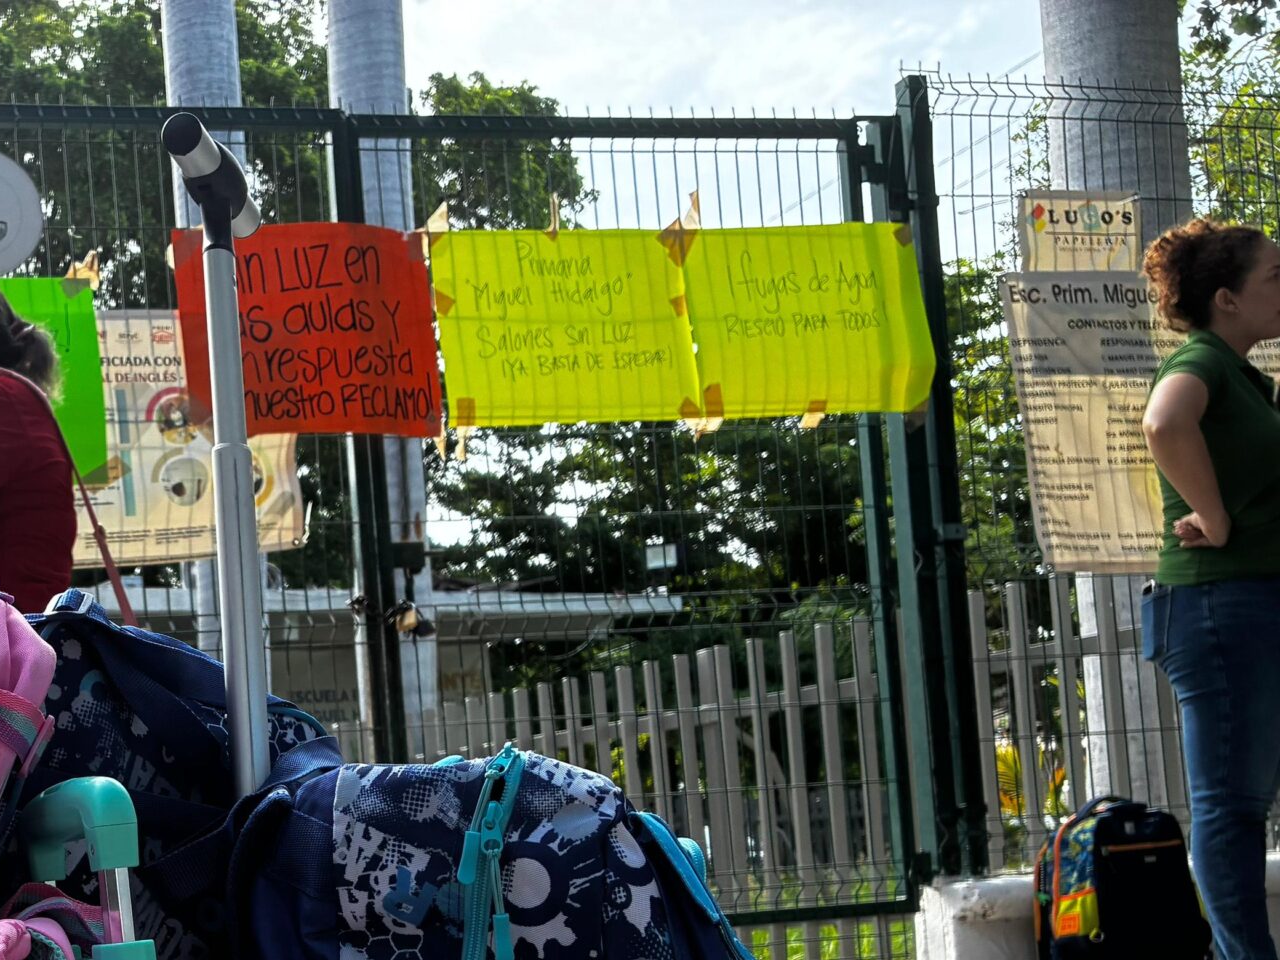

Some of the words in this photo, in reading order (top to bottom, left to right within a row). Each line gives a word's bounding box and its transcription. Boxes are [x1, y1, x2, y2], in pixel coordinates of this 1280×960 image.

[275, 244, 342, 293] LUZ
[344, 244, 380, 284] en
[513, 238, 593, 278] Primaria
[808, 258, 830, 293] de
[832, 260, 878, 305] Agua
[1008, 284, 1048, 304] Esc.
[1051, 283, 1099, 304] Prim.
[1103, 284, 1159, 309] Migue
[283, 293, 374, 335] aulas
[381, 301, 400, 344] Y
[1067, 318, 1127, 331] CONTACTOS
[1128, 319, 1136, 331] Y
[477, 325, 554, 359] Salones
[602, 320, 635, 345] LUZ
[115, 372, 132, 383] DE
[133, 369, 179, 383] INGLÉS
[153, 356, 182, 367] CON
[266, 340, 414, 386] respuesta
[538, 353, 581, 376] BASTA
[586, 353, 605, 371] DE
